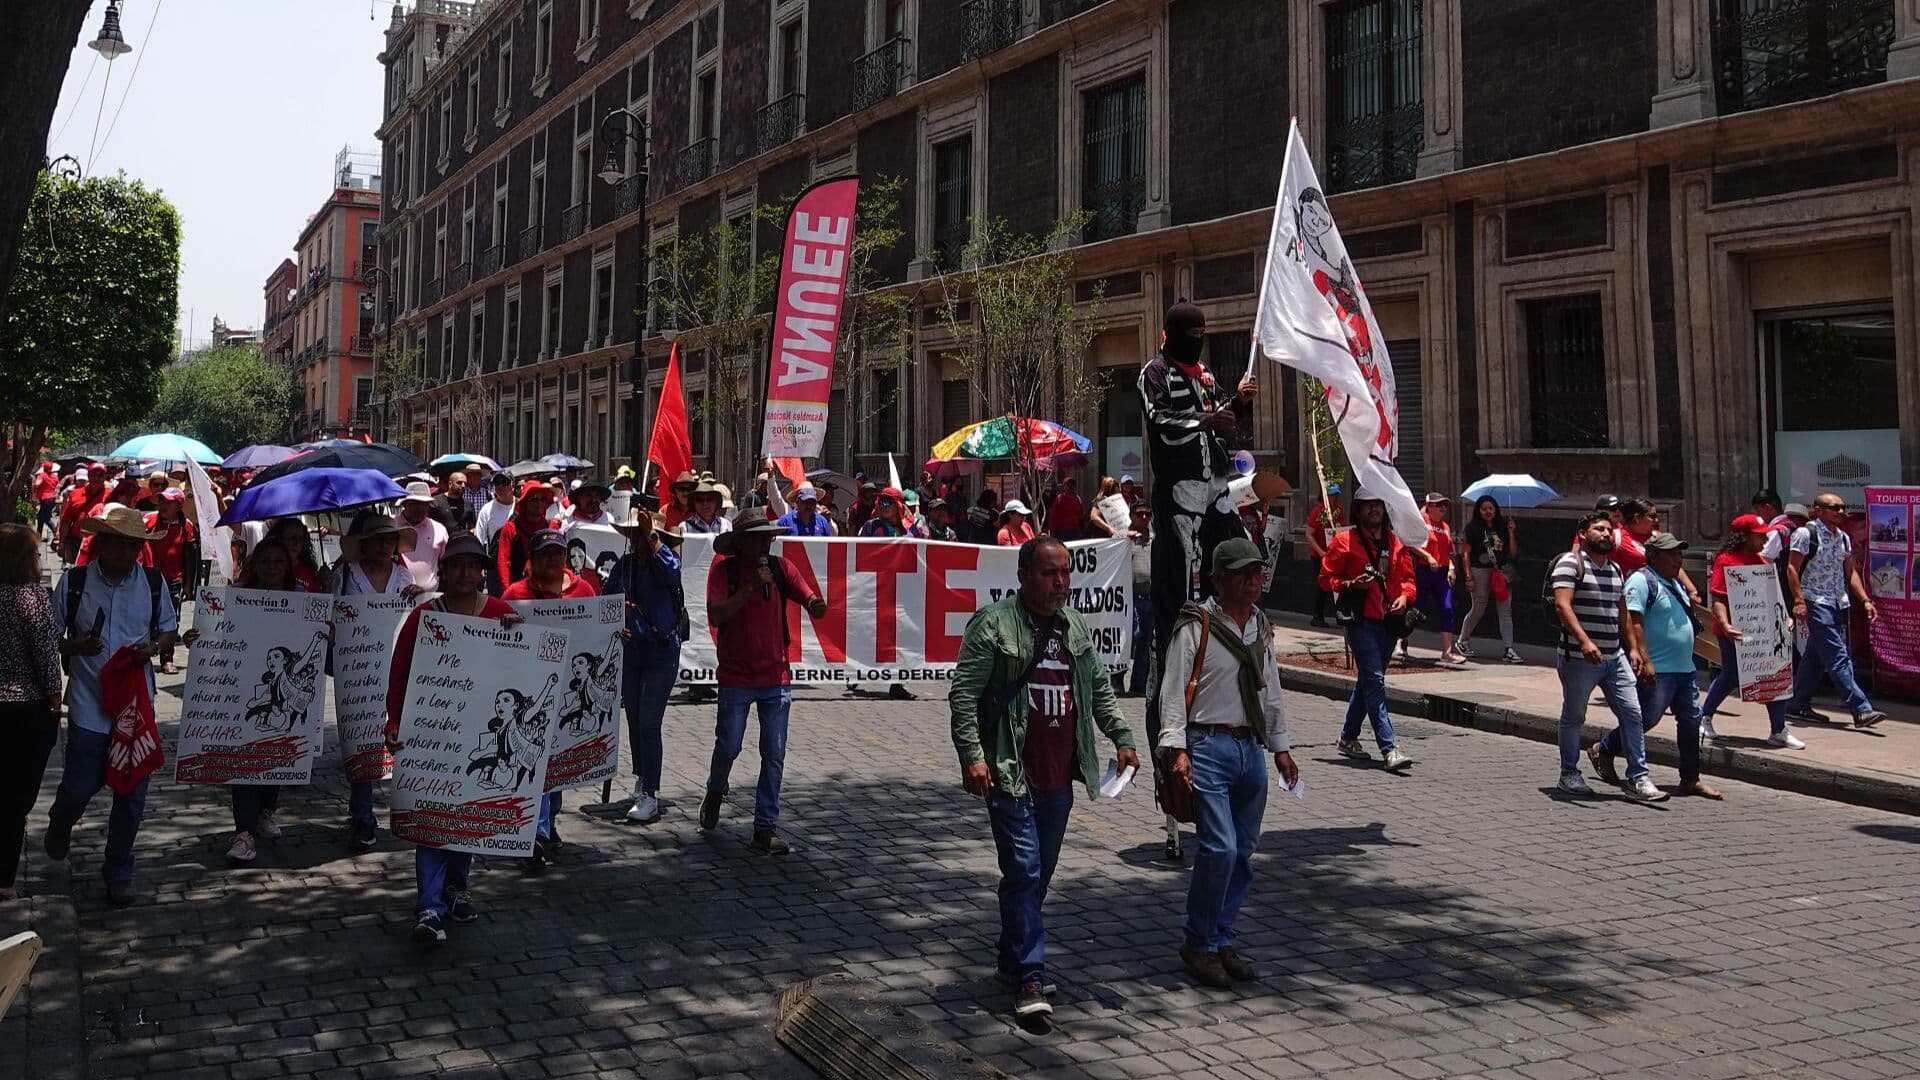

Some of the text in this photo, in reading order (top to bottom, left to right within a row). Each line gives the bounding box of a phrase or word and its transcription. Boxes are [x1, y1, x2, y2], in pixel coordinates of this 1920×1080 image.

[1877, 495, 1908, 503] TOURS
[235, 595, 289, 608] Sección 9
[706, 541, 979, 663] NTE
[532, 604, 586, 617] Sección 9
[215, 620, 236, 633] Me
[352, 625, 370, 638] Me
[462, 624, 523, 643] Sección 9
[196, 638, 248, 652] enseñaste
[338, 640, 385, 656] enseñaste
[437, 652, 461, 668] Me
[538, 646, 564, 661] 2024
[209, 654, 229, 667] leer
[234, 659, 242, 670] y
[352, 659, 370, 671] leer
[415, 672, 475, 692] enseñaste
[857, 669, 892, 681] LOS
[191, 690, 241, 703] ahora me
[341, 693, 385, 706] ahora me
[416, 693, 466, 712] a leer y
[187, 709, 241, 721] enseñas a
[341, 710, 378, 723] enseñas
[413, 716, 462, 734] escribir,
[405, 734, 463, 753] ahora me
[400, 756, 449, 773] enseñas
[452, 765, 461, 775] a
[396, 773, 463, 797] LUCHAR.
[483, 838, 532, 850] VENCEREMOS!
